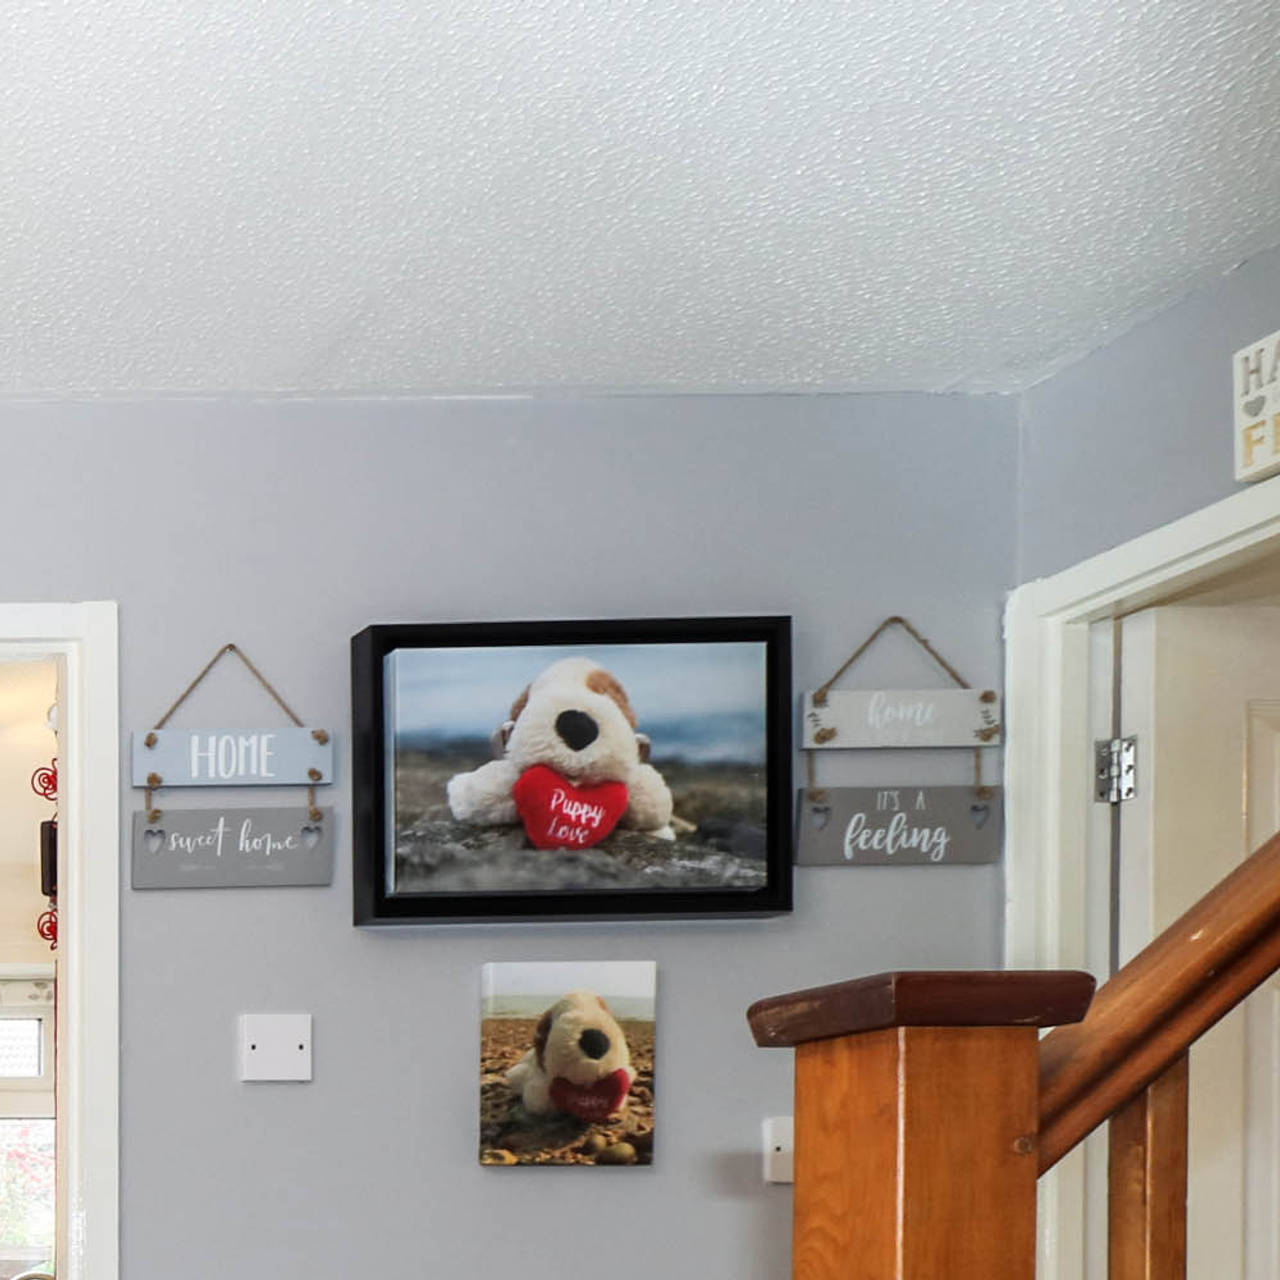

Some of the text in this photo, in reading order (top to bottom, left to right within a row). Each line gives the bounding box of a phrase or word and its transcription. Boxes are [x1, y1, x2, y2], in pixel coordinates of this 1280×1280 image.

[867, 690, 936, 729] home
[190, 733, 277, 779] HOME
[550, 788, 606, 828] Puppy
[876, 790, 926, 811] IT'S A
[168, 816, 299, 856] sweet home
[843, 812, 951, 862] feeling
